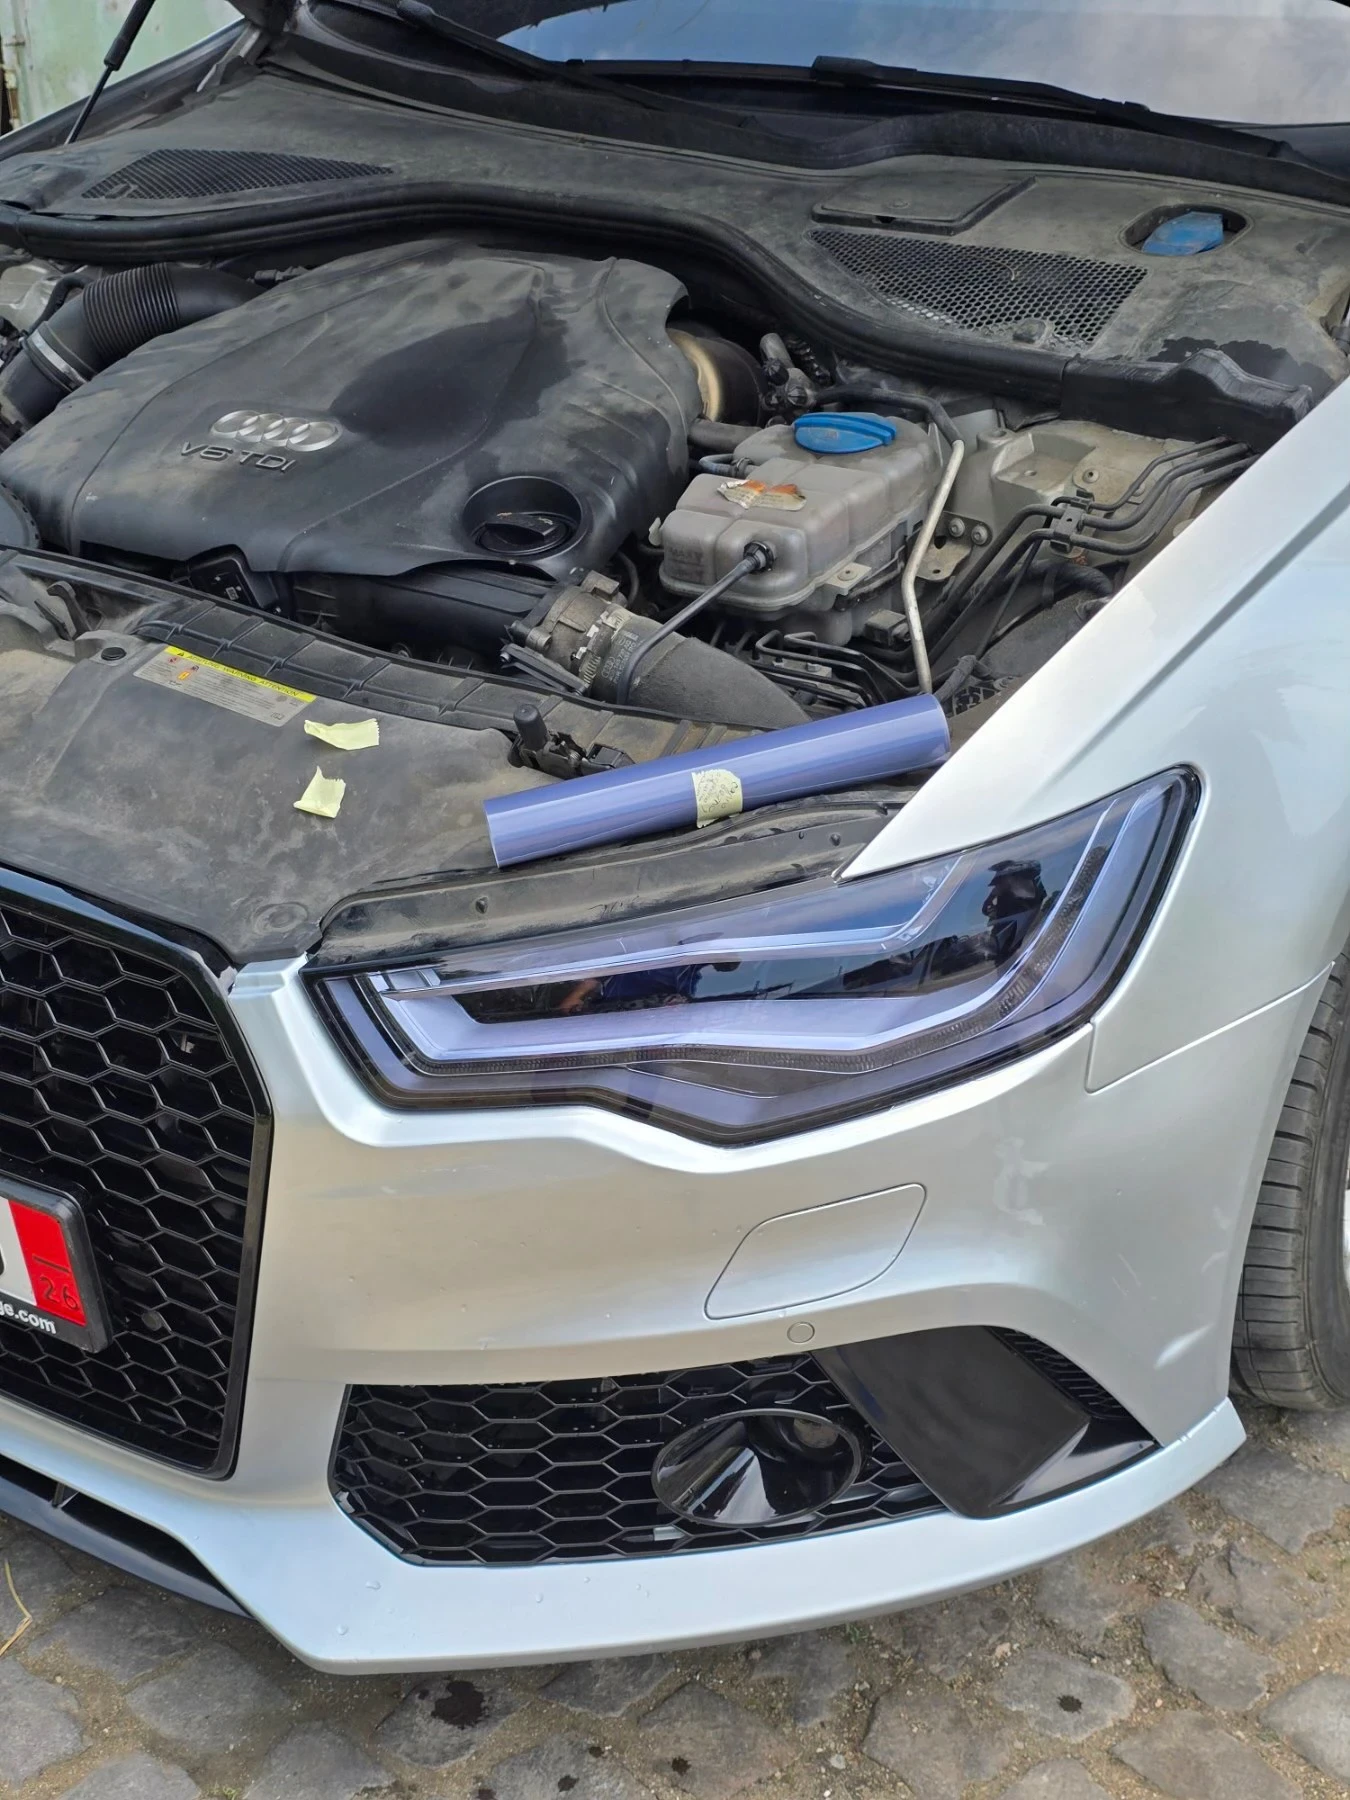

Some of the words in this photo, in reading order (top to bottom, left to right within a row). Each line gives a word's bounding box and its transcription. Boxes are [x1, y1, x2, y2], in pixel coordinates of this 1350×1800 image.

[181, 441, 234, 461] V6
[239, 450, 296, 473] TDI
[223, 667, 256, 681] WARNING
[259, 680, 300, 696] ATTENTION
[39, 1275, 80, 1311] 26
